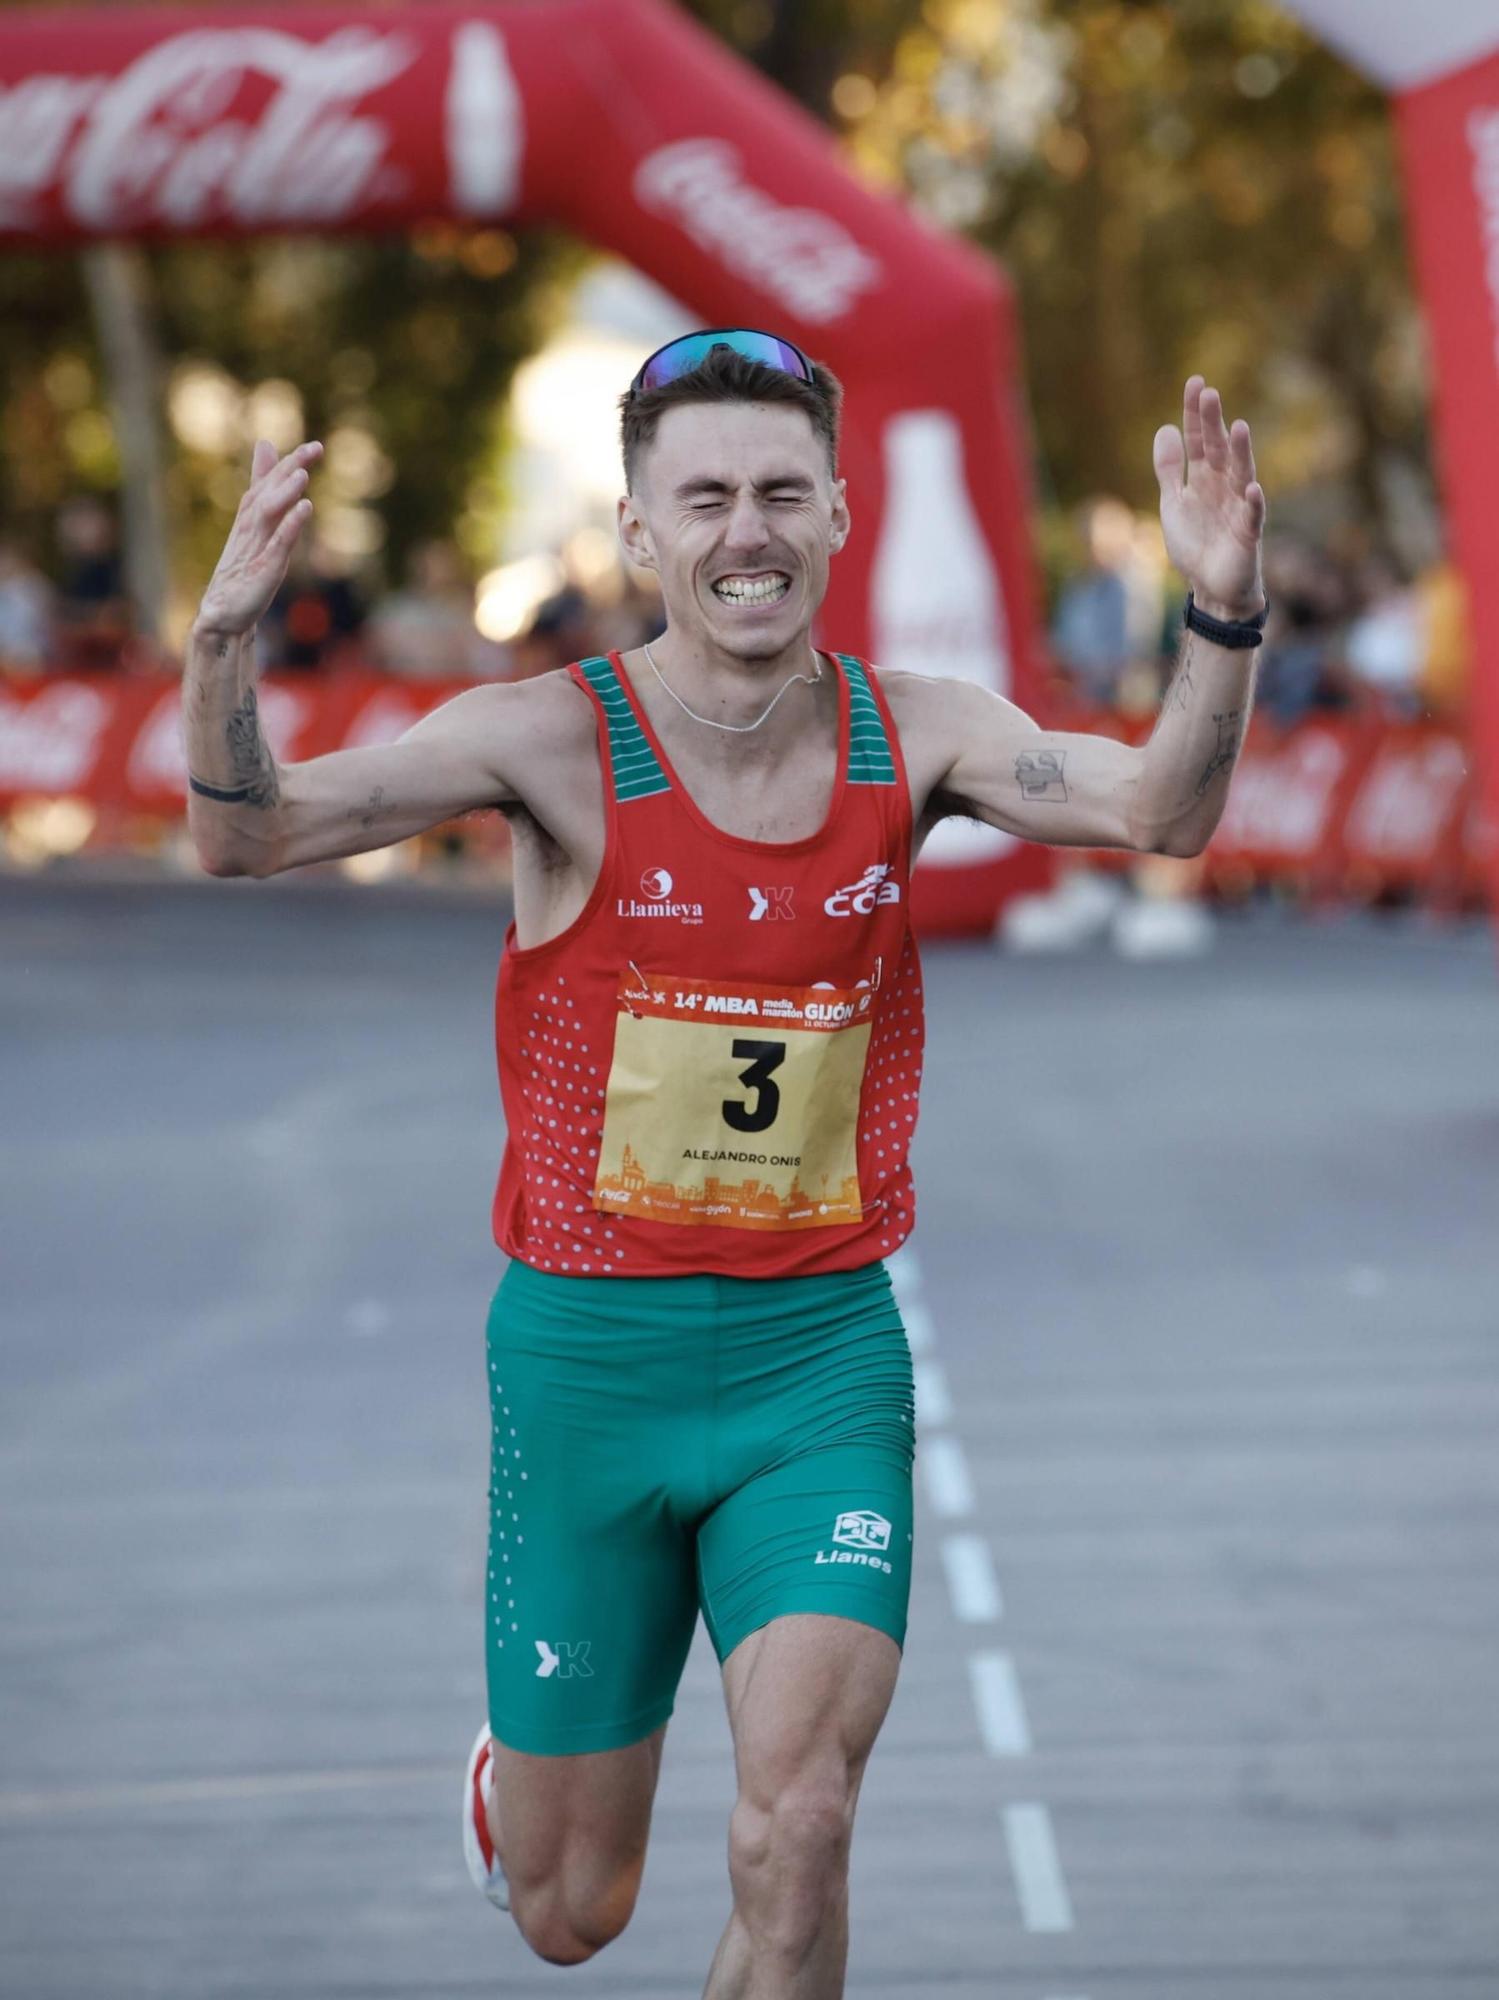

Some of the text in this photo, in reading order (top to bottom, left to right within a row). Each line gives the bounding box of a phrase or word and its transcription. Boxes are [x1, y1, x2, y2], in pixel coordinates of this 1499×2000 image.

[617, 899, 703, 917] Llamieva
[704, 995, 759, 1016] MBA
[762, 1008, 803, 1019] maratón
[763, 999, 793, 1009] media
[804, 1001, 855, 1021] GIJÓN
[722, 1039, 786, 1133] 3
[682, 1149, 801, 1167] ALEJANDRO ONIS
[814, 1549, 892, 1575] Llanes
